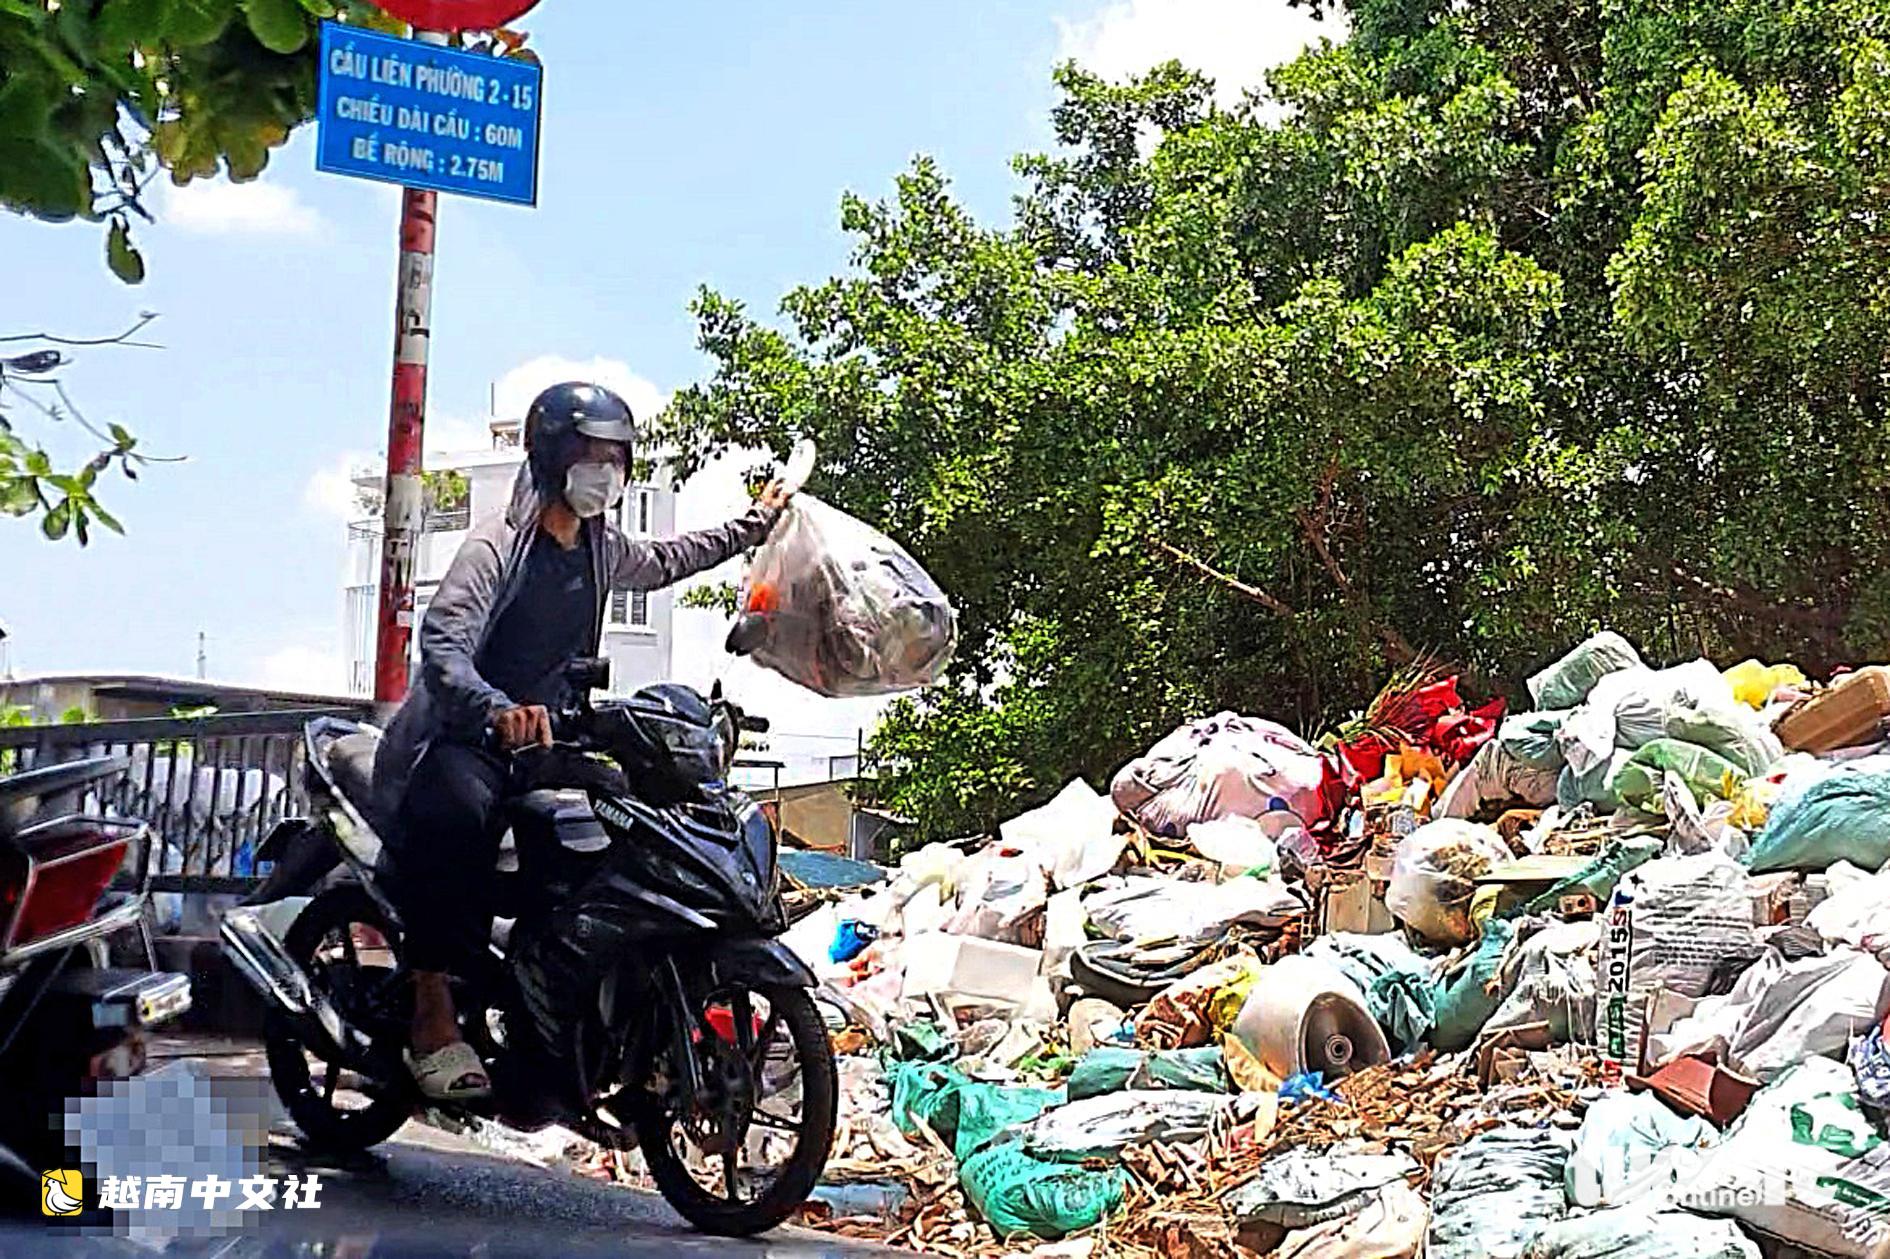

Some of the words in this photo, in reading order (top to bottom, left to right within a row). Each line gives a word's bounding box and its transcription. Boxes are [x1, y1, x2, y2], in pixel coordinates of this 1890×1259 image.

[371, 51, 412, 88] LIÊN
[489, 79, 500, 104] 2
[512, 84, 532, 111] 15
[397, 104, 429, 133] DÀI
[485, 123, 522, 151] 60M
[450, 154, 504, 184] 2.75M
